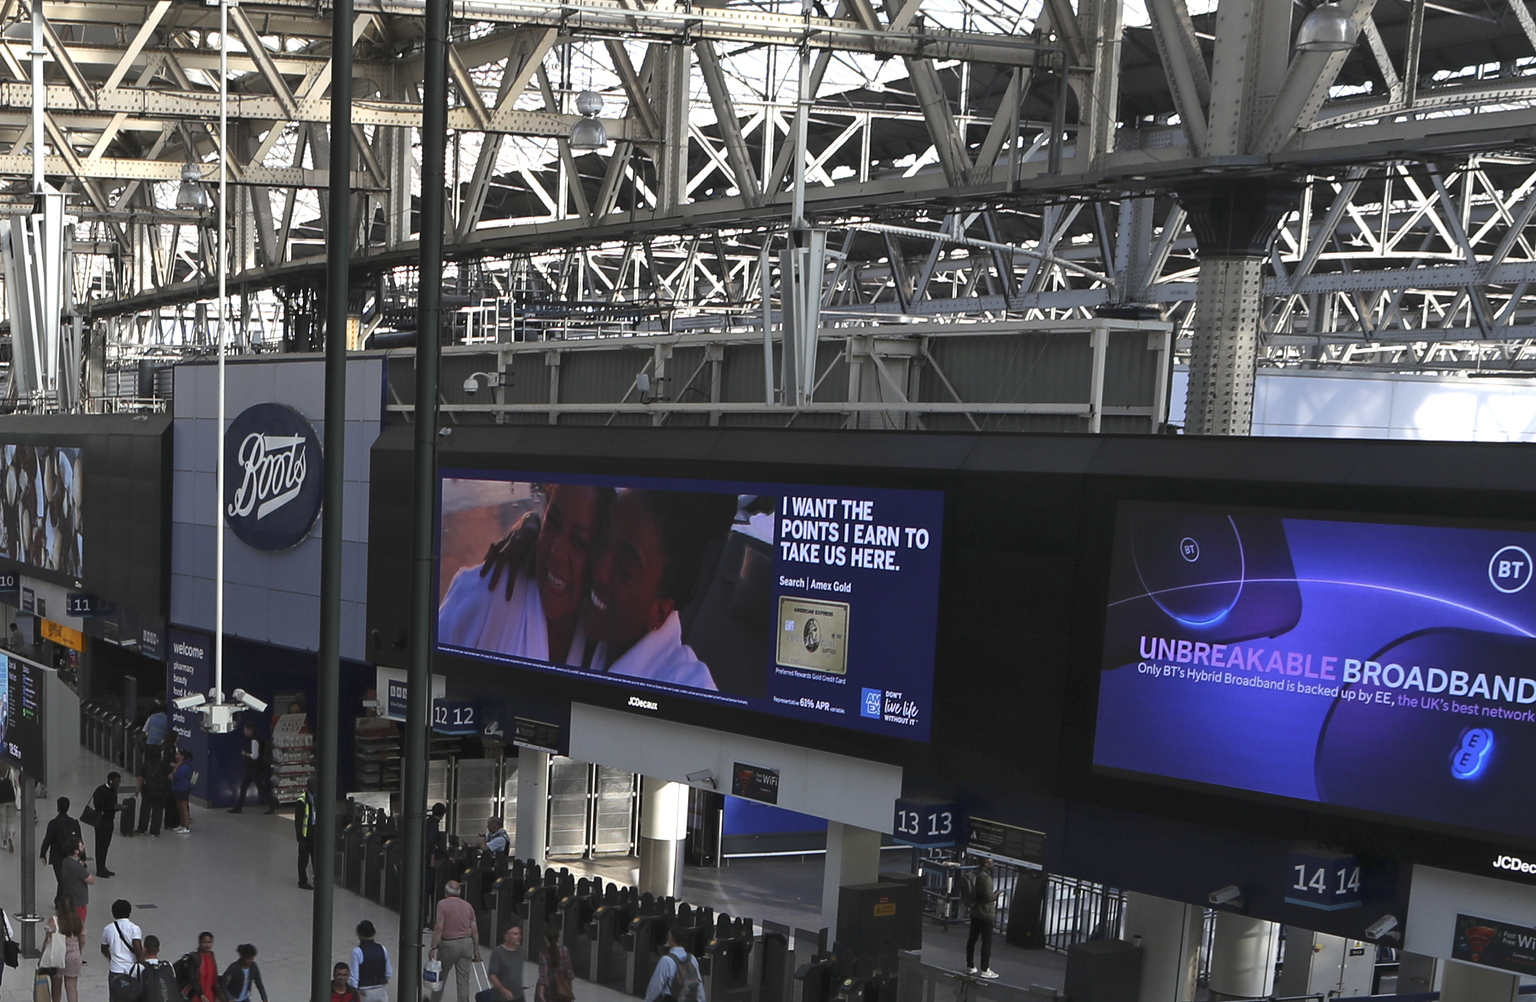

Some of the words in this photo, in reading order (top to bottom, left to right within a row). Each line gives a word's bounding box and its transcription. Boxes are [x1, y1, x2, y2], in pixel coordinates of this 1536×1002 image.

[227, 432, 307, 520] Boots
[782, 496, 787, 516] I
[792, 496, 837, 519] WANT
[841, 499, 874, 521] THE
[781, 519, 839, 542] POINTS
[844, 523, 849, 543] I
[853, 525, 900, 547] EARN
[905, 527, 930, 549] TO
[780, 541, 820, 563] TAKE
[824, 545, 846, 566] US
[850, 547, 900, 571] HERE.
[1184, 544, 1195, 555] BT
[1497, 560, 1525, 580] BT
[0, 575, 14, 587] 10
[779, 575, 805, 588] Search
[810, 579, 832, 592] Amex
[833, 581, 852, 593] Gold
[74, 599, 91, 611] 11
[814, 609, 834, 617] EXPRESS
[173, 641, 204, 660] welcome
[173, 661, 194, 675] pharmacy
[775, 667, 794, 677] Preferred
[794, 670, 812, 679] Rewards
[811, 673, 822, 681] Gold
[822, 675, 835, 683] Credit
[835, 677, 846, 685] Card
[1139, 636, 1338, 681] UNBREAKABLE
[1342, 658, 1536, 704] BROADBAND
[173, 674, 187, 687] beauty
[173, 686, 183, 697] food
[885, 690, 902, 700] DON'T
[1137, 662, 1162, 677] Only
[1163, 666, 1185, 679] BT's
[1187, 669, 1222, 684] Hybrid
[1224, 673, 1284, 691] Broadband
[1286, 681, 1295, 692] is
[1297, 681, 1339, 698] backed
[1341, 689, 1356, 702] up
[1358, 690, 1373, 705] by
[1374, 691, 1395, 708] EE,
[1397, 694, 1418, 708] the
[1421, 697, 1449, 712] UK's
[1451, 700, 1479, 715] best
[1481, 706, 1535, 722] network
[627, 696, 658, 710] JCDecaux
[772, 695, 799, 706] Representative
[799, 697, 815, 708] 61%
[815, 700, 830, 712] APR
[884, 698, 902, 713] live
[902, 701, 919, 718] life
[173, 713, 185, 723] photo
[435, 706, 448, 725] 12
[453, 707, 474, 725] 12
[884, 714, 909, 725] WITHOUT
[172, 725, 192, 738] electrical
[1467, 734, 1481, 748] E
[1459, 752, 1472, 767] E
[762, 774, 778, 786] WiFi
[898, 810, 919, 834] 13
[928, 812, 952, 836] 13
[1492, 855, 1536, 874] JCDec
[1293, 864, 1327, 895] 14
[1335, 866, 1361, 895] 14
[1502, 931, 1516, 939] Fast
[1502, 937, 1516, 946] Free
